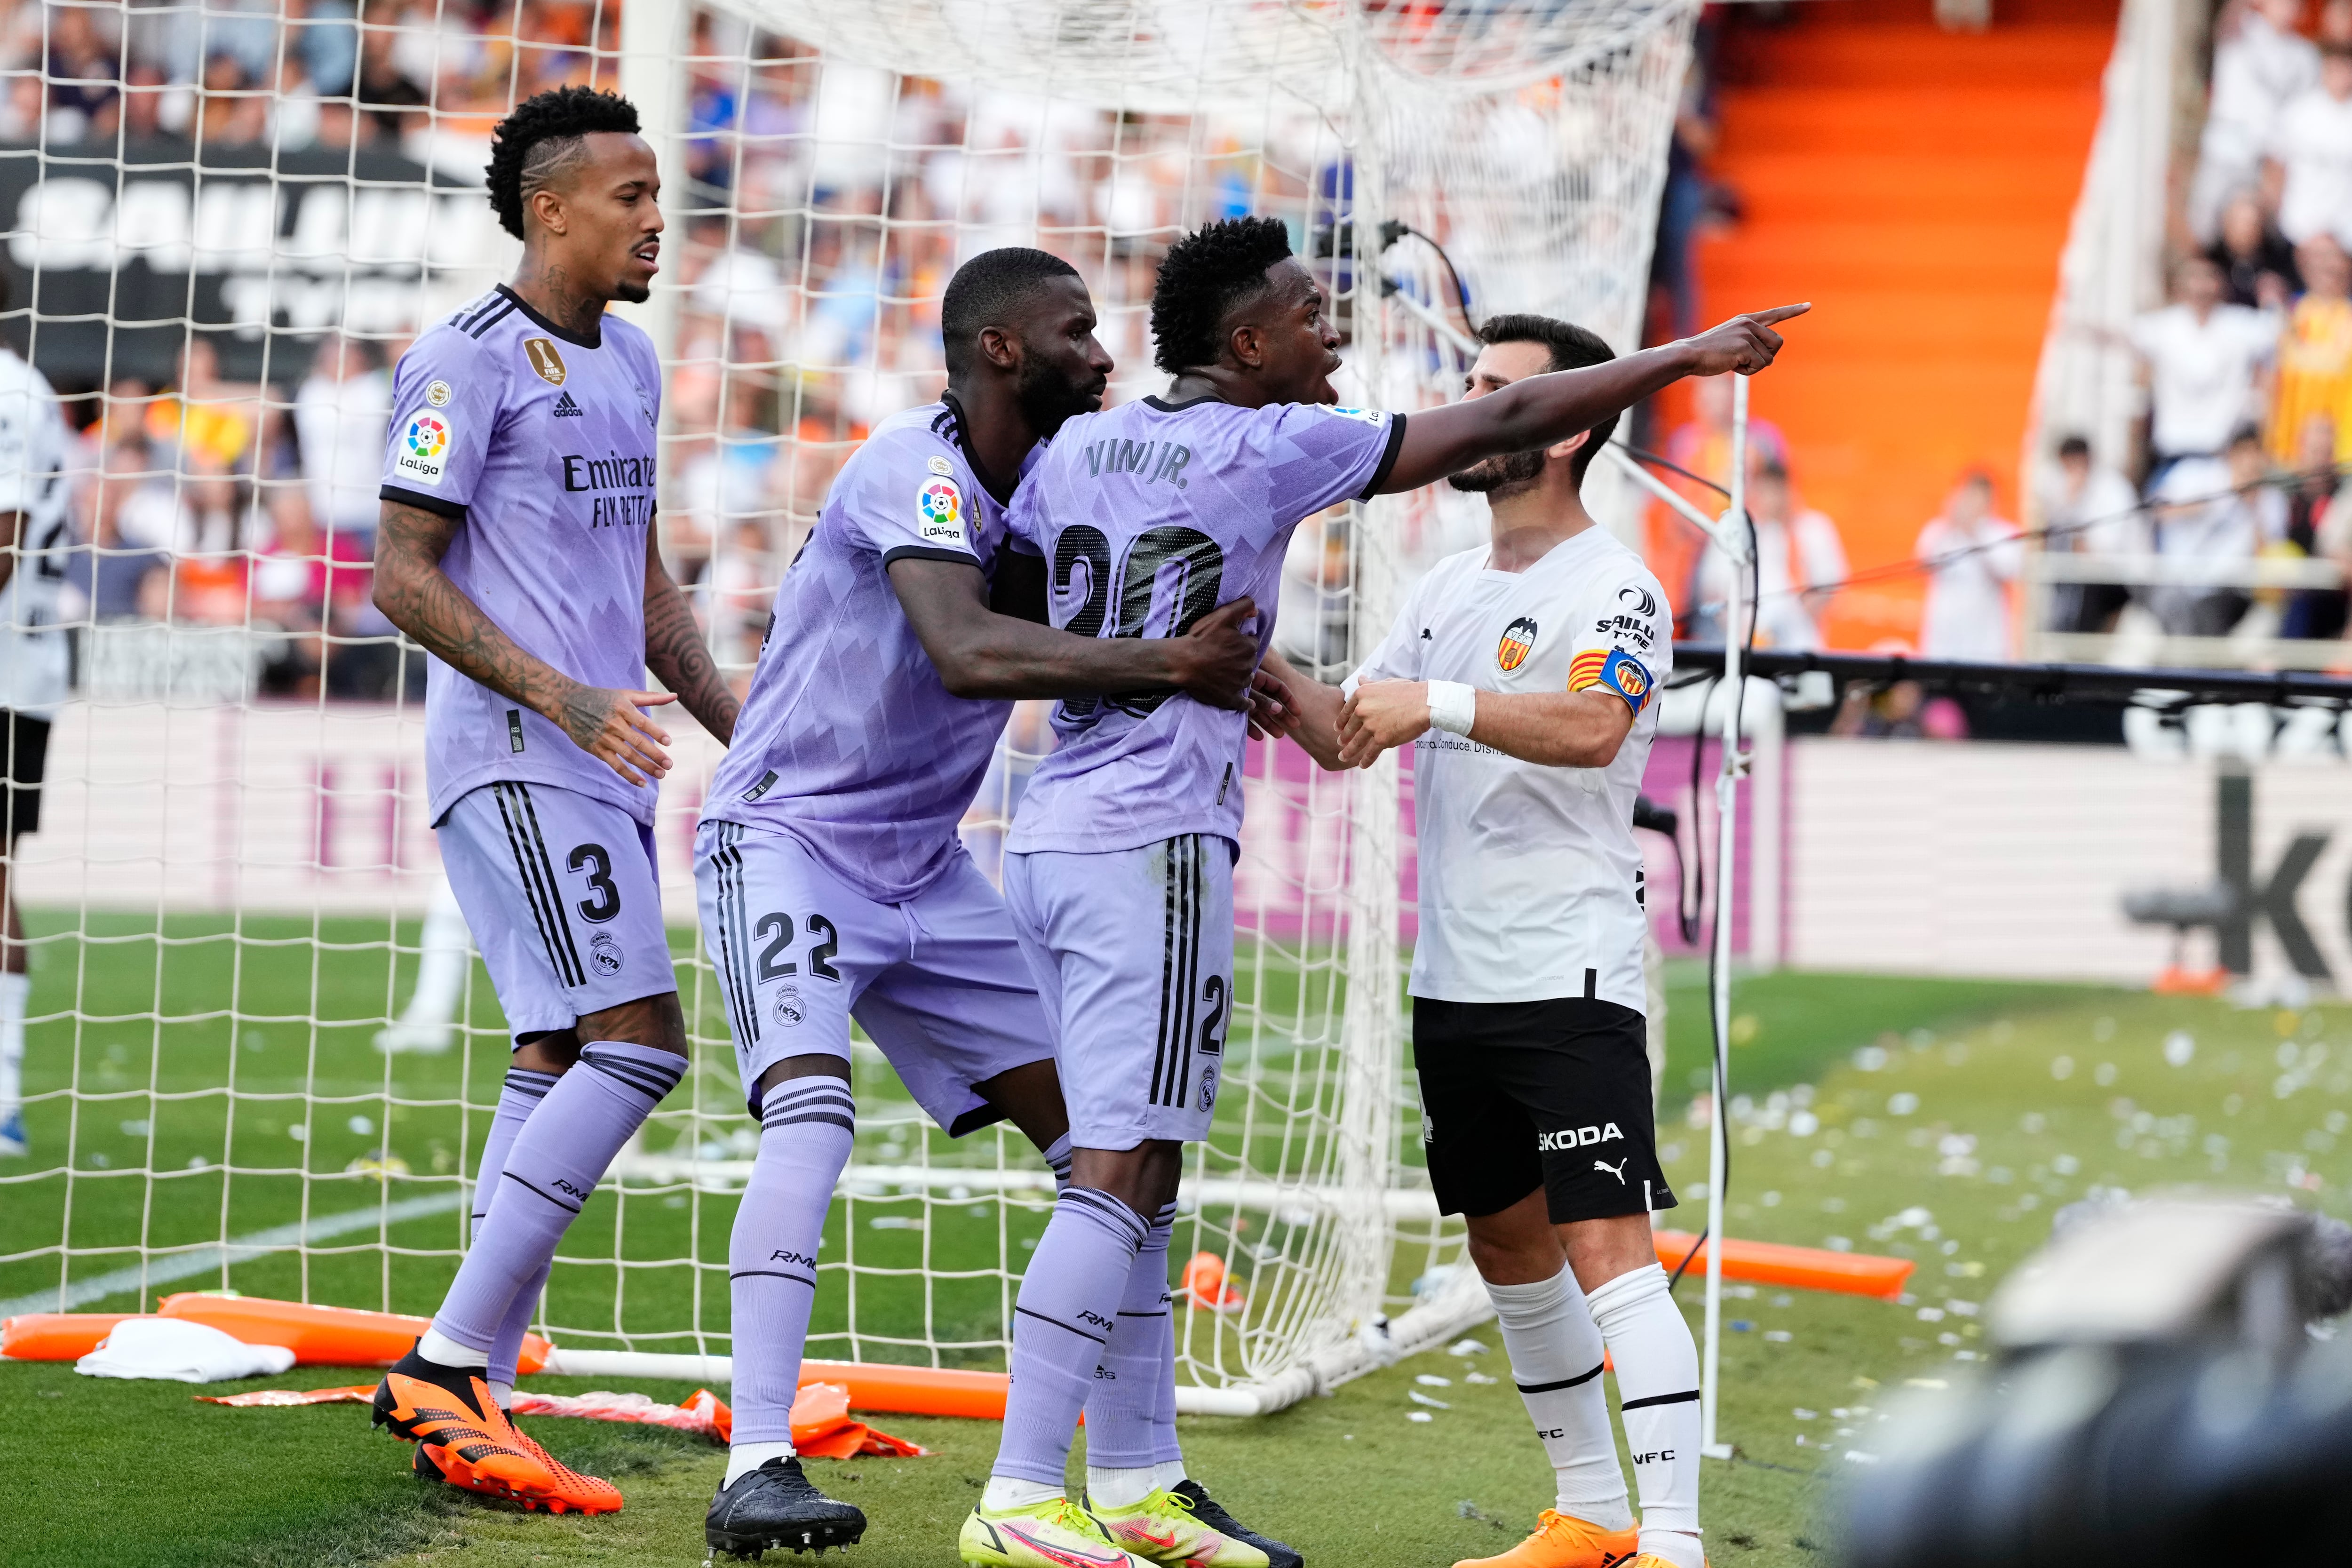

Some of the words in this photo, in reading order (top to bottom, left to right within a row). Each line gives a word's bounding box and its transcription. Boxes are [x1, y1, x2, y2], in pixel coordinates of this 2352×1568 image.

[554, 407, 583, 417] adidas
[400, 456, 438, 474] LaLiga
[1086, 438, 1154, 478] VINI
[1146, 442, 1191, 489] JR.
[593, 496, 615, 528] FLY
[924, 526, 960, 538] LaLiga
[1053, 525, 1223, 723] 20
[1614, 630, 1650, 650] TYRE
[1438, 738, 1471, 752] Conduce.
[566, 844, 620, 924] 3
[754, 912, 841, 986] 22
[1633, 1450, 1676, 1464] VFC
